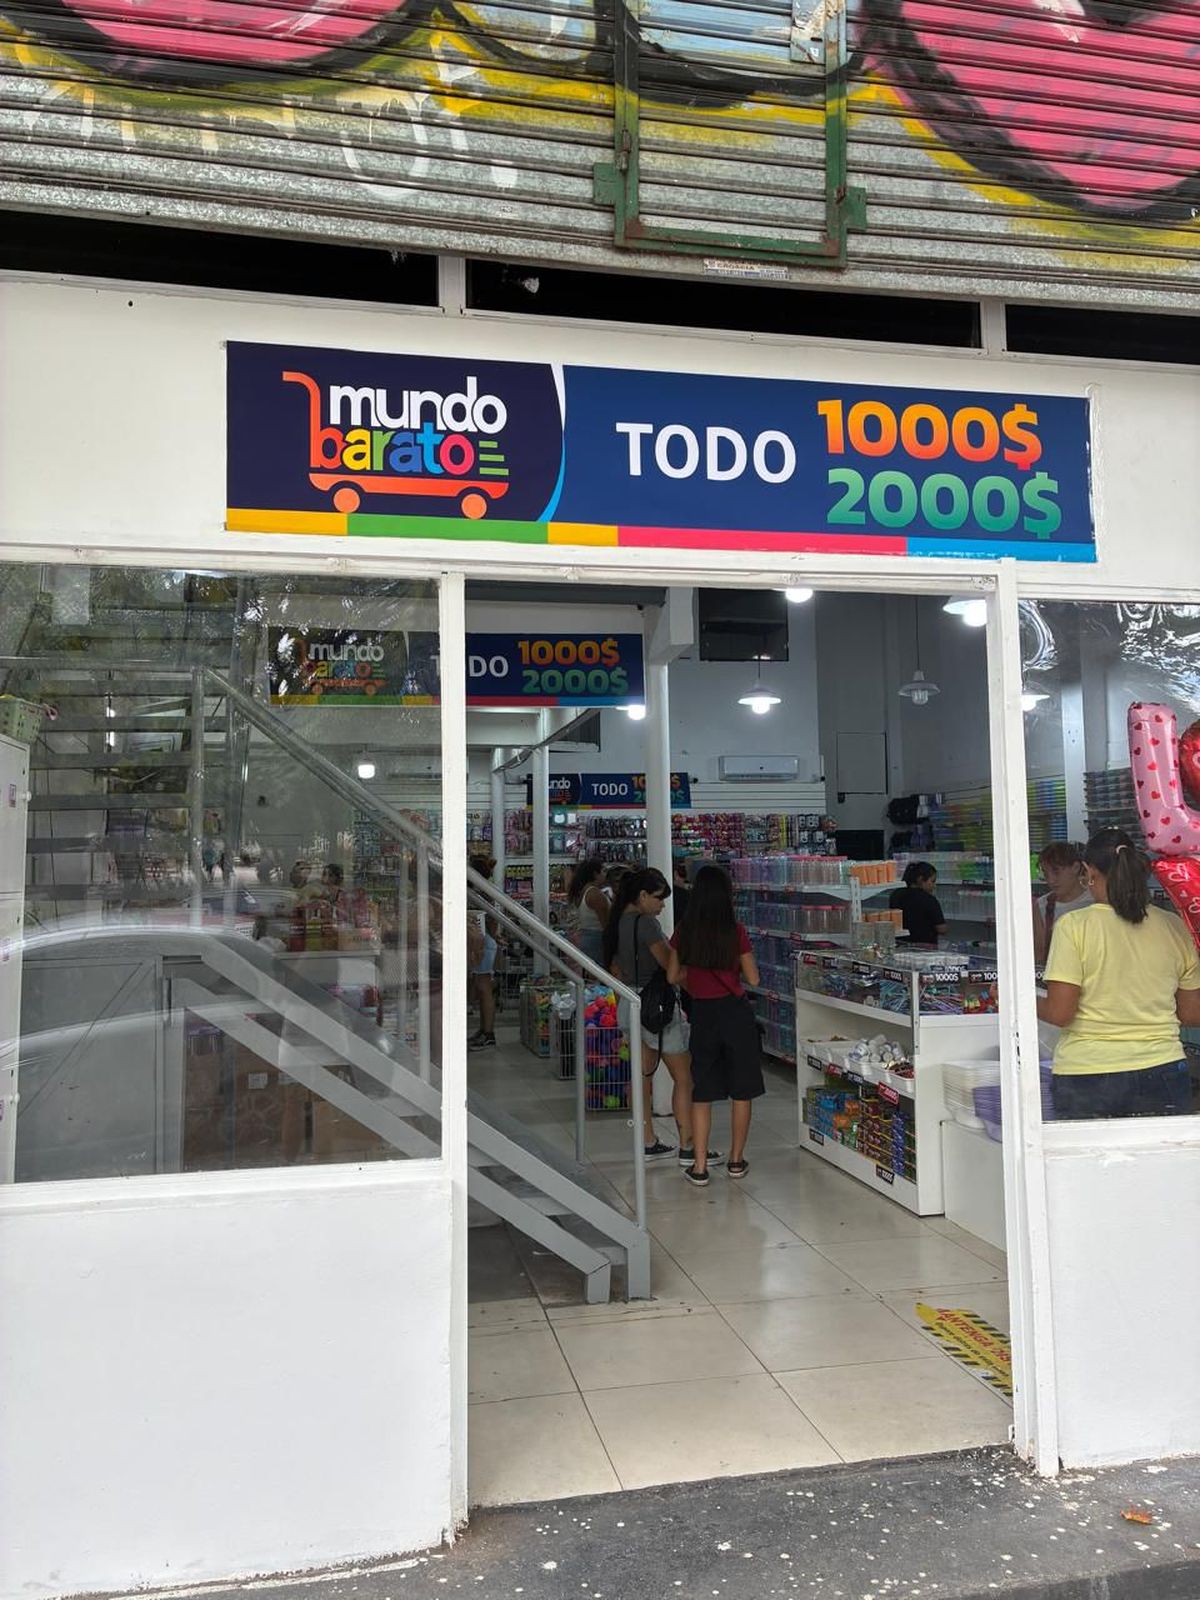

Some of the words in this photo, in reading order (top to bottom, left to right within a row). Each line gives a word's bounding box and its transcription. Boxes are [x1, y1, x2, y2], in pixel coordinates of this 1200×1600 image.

[329, 376, 508, 433] mundo
[310, 422, 474, 475] barato
[817, 399, 1042, 470] 1000$
[615, 422, 796, 484] TODO
[827, 468, 1062, 540] 2000$
[308, 638, 385, 662] mundo
[517, 638, 620, 666] 1000$
[430, 655, 509, 678] TDO
[521, 666, 629, 696] 2000$
[548, 777, 571, 790] undo
[591, 783, 628, 796] TODO
[983, 971, 999, 980] 100
